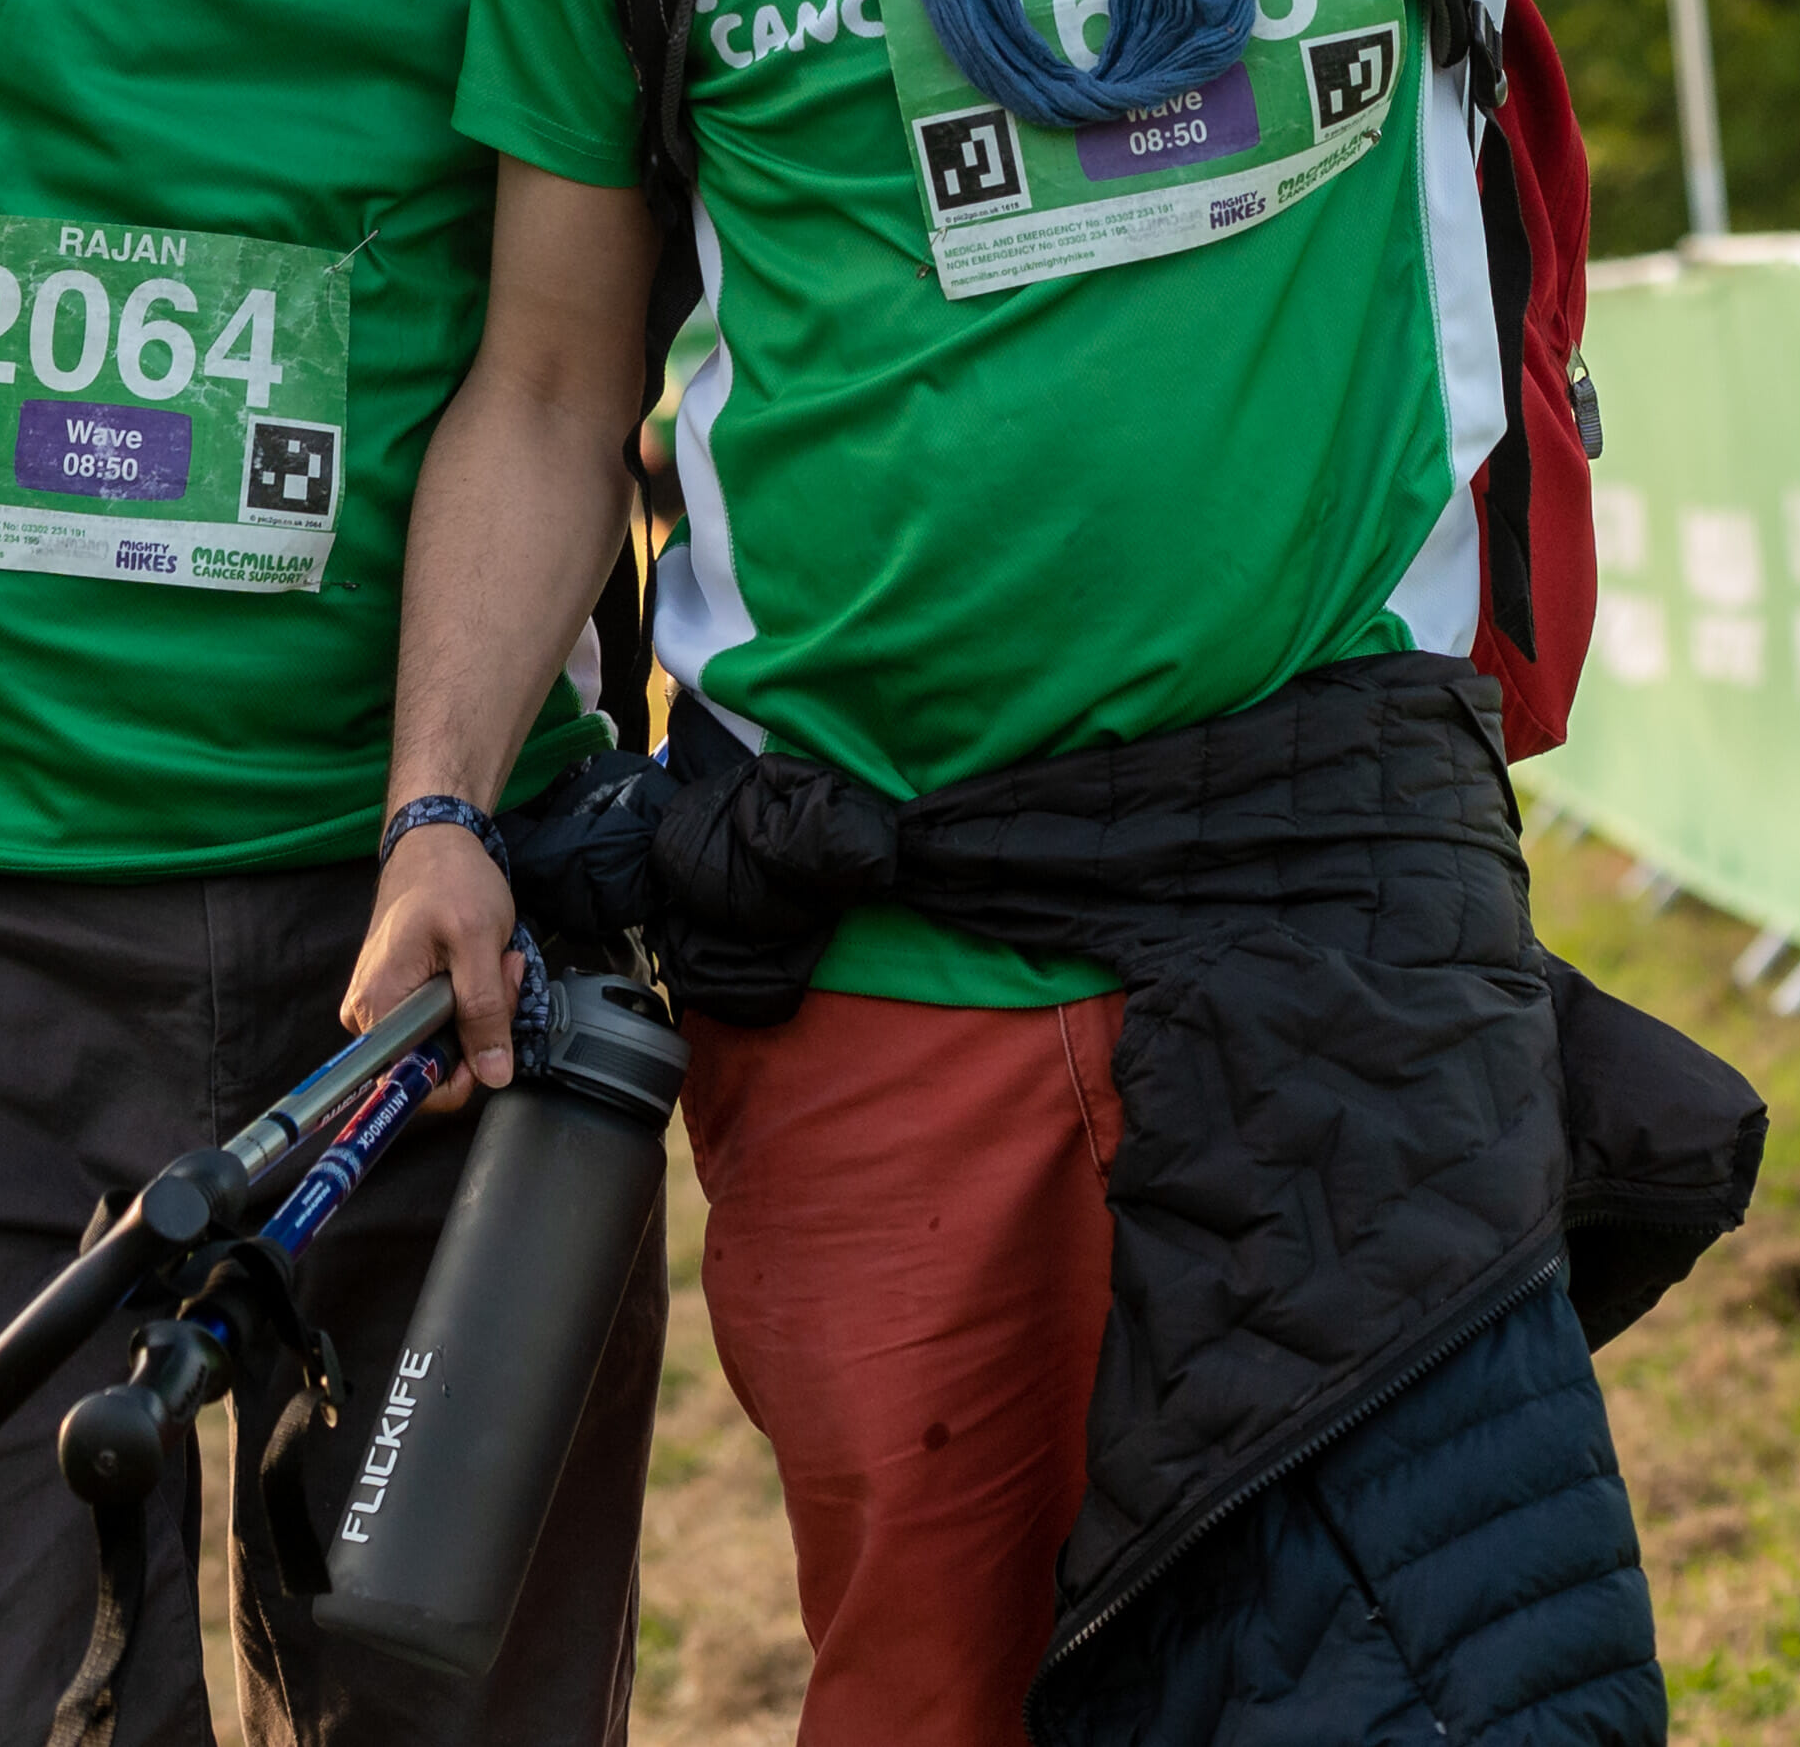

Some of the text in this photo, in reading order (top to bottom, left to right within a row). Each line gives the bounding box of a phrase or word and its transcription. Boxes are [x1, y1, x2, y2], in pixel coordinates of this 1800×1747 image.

[1129, 119, 1207, 156] 08:50
[1209, 190, 1259, 212] MIGHTY
[1209, 197, 1267, 230] HIKES
[59, 226, 187, 267] RAJAN
[943, 241, 991, 259] MEDICAL
[992, 235, 1015, 250] AND
[1016, 221, 1083, 245] EMERGENCY
[946, 258, 970, 271] NON
[971, 244, 1036, 267] EMERGENCY
[66, 419, 143, 450] Wave
[62, 452, 139, 482] 08:50
[119, 539, 170, 554] MIGHTY
[191, 545, 315, 573] MACMILLAN
[116, 550, 178, 574] HIKES
[192, 565, 302, 585] CANCER SUPPORT
[356, 1088, 409, 1151] ANTISHOCK
[340, 1346, 434, 1545] FLICKIFE
